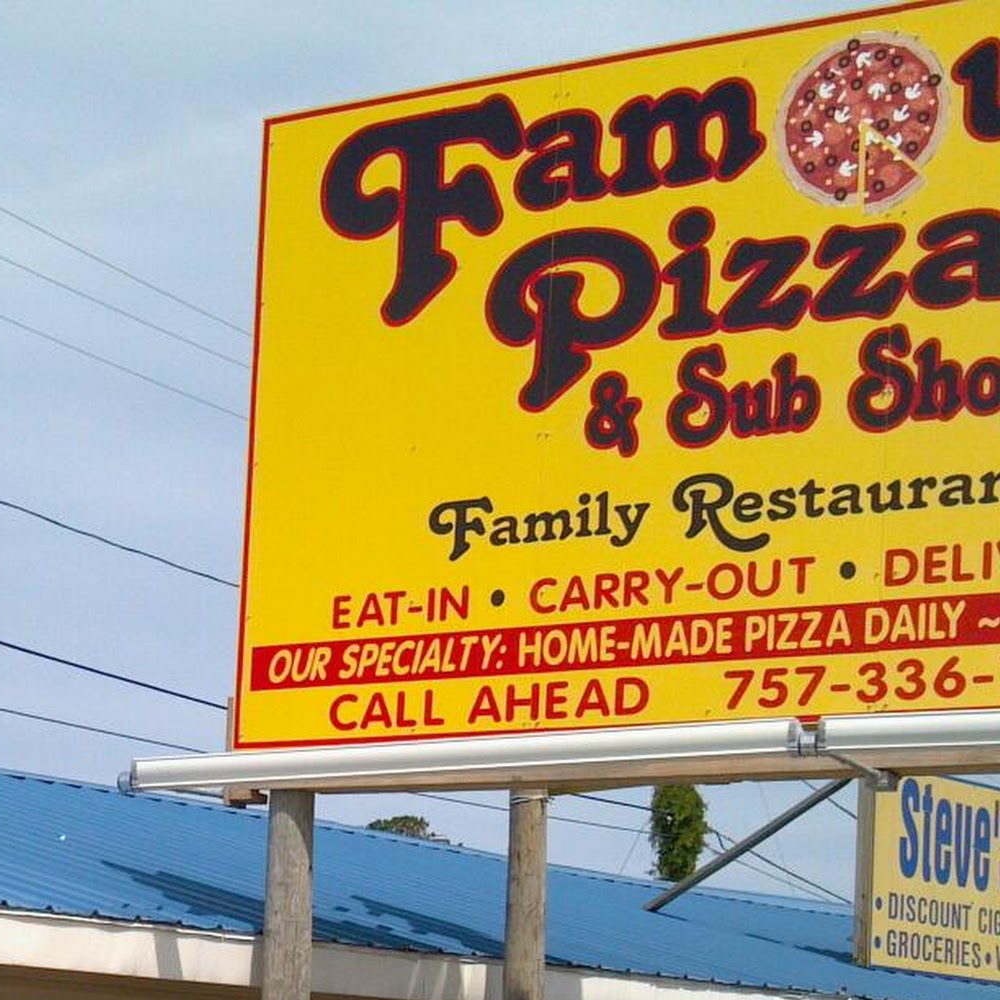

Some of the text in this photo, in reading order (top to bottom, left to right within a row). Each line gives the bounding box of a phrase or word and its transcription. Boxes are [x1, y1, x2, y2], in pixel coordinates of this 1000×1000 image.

[485, 206, 1000, 414] Pizza
[585, 324, 1000, 456] & Sub Sho
[429, 491, 650, 562] Family
[333, 541, 1000, 630] EAT-IN CARRY-OUT DELI
[267, 600, 966, 684] OUR SPECIALTY: HOME-MADE PIZZA DAILY
[328, 688, 444, 731] CALL
[468, 677, 650, 724] AHEAD
[886, 930, 981, 968] GROCERIES
[888, 892, 972, 931] DISCOUNT
